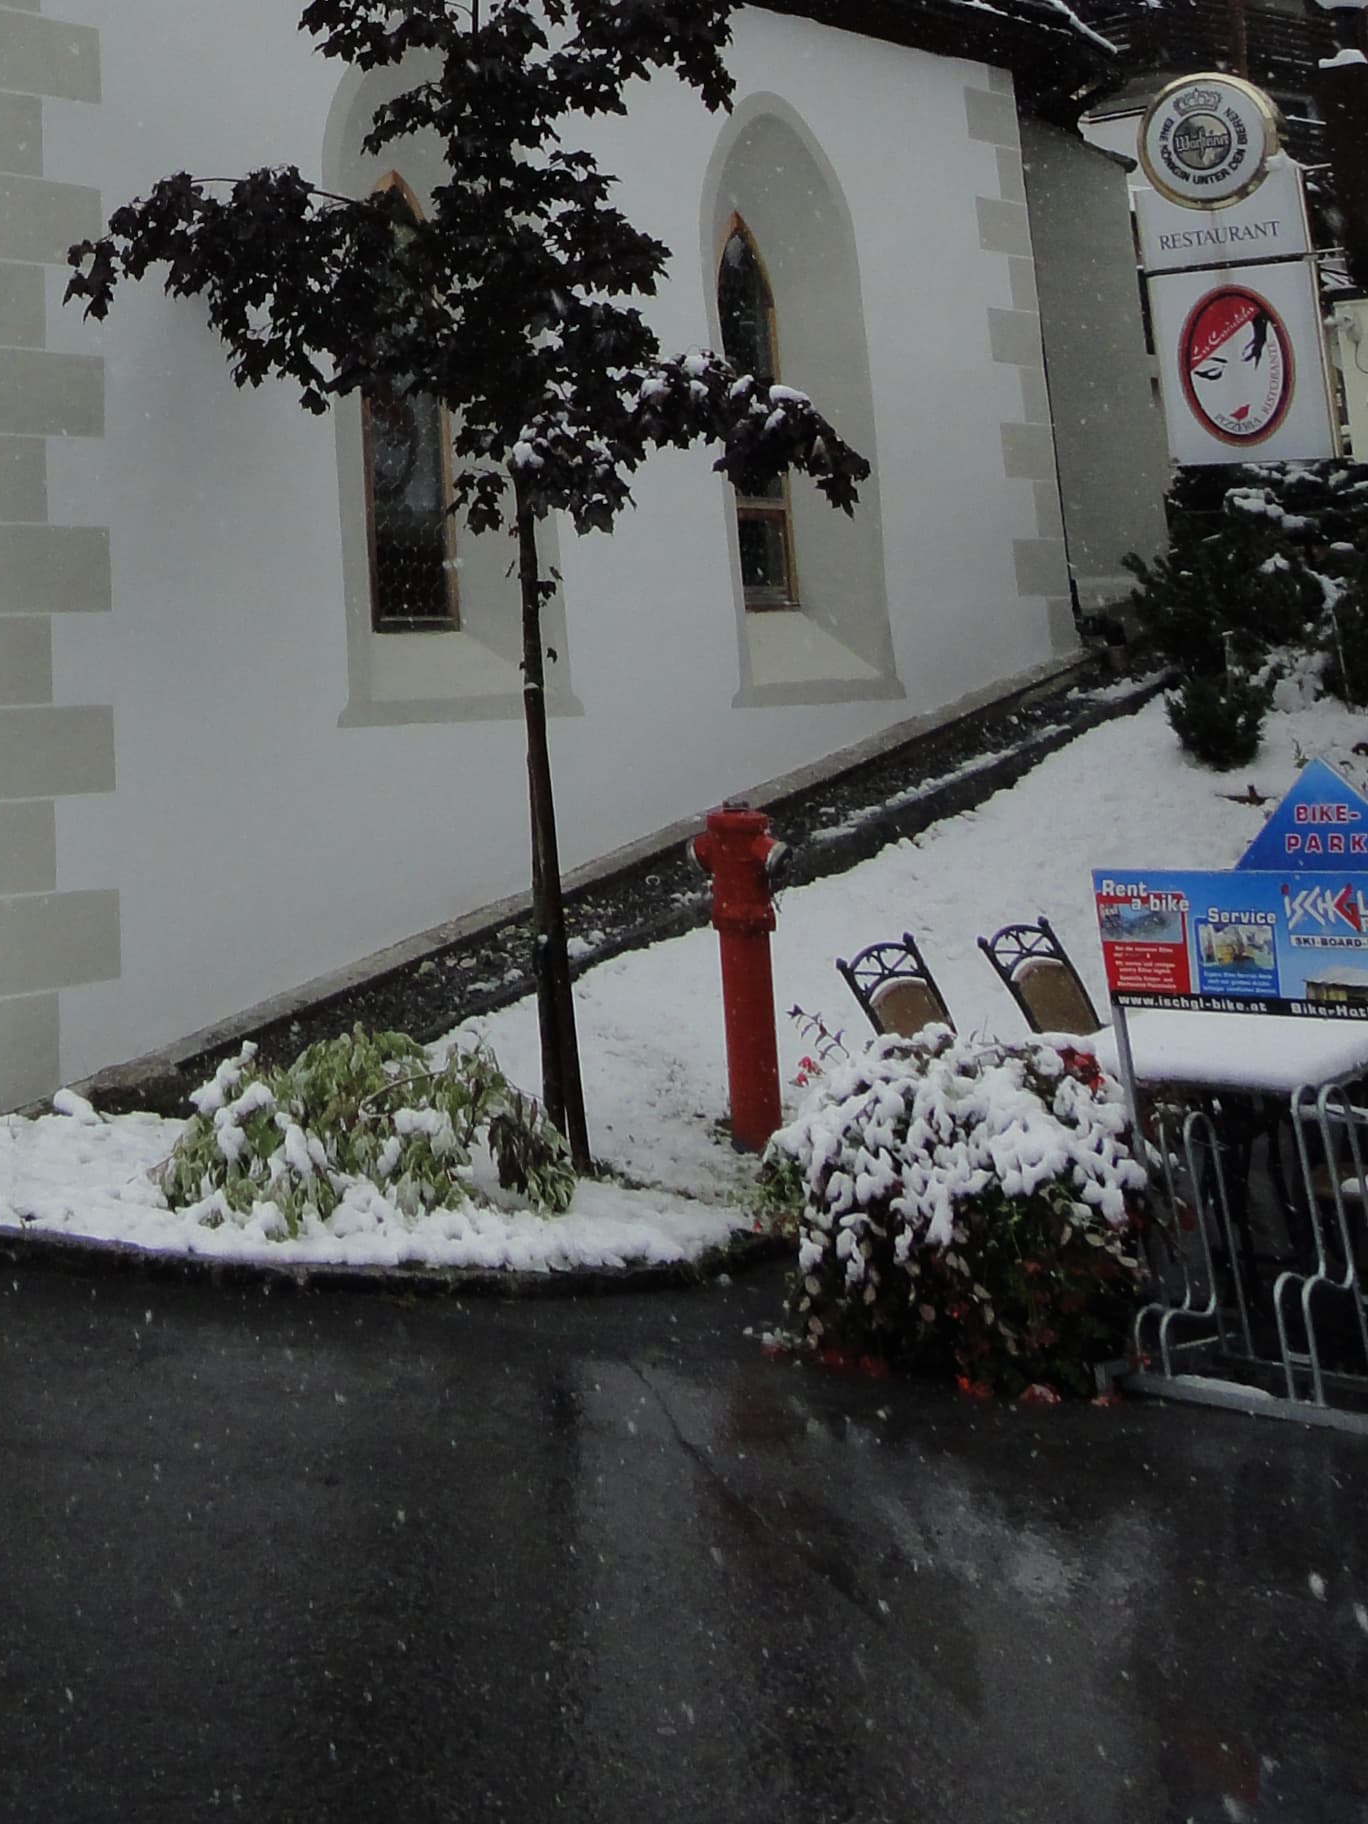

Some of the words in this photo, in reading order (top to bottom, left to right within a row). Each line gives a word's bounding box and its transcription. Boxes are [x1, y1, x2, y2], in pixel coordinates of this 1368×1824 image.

[1159, 117, 1175, 141] EINE
[1223, 107, 1248, 145] BIEREN
[1228, 148, 1247, 170] DEN
[1192, 167, 1230, 185] UNTER
[1159, 220, 1281, 251] RESTAURANT
[1214, 412, 1262, 433] PIZZERIA
[1261, 344, 1282, 415] RISTORANTE
[1294, 803, 1362, 824] BIKE-
[1284, 832, 1368, 854] PARK
[1101, 879, 1148, 897] Rent
[1131, 897, 1142, 911] a
[1149, 894, 1190, 912] bike
[1207, 907, 1276, 924] Service
[1118, 995, 1267, 1012] www.ischgl-bike.at
